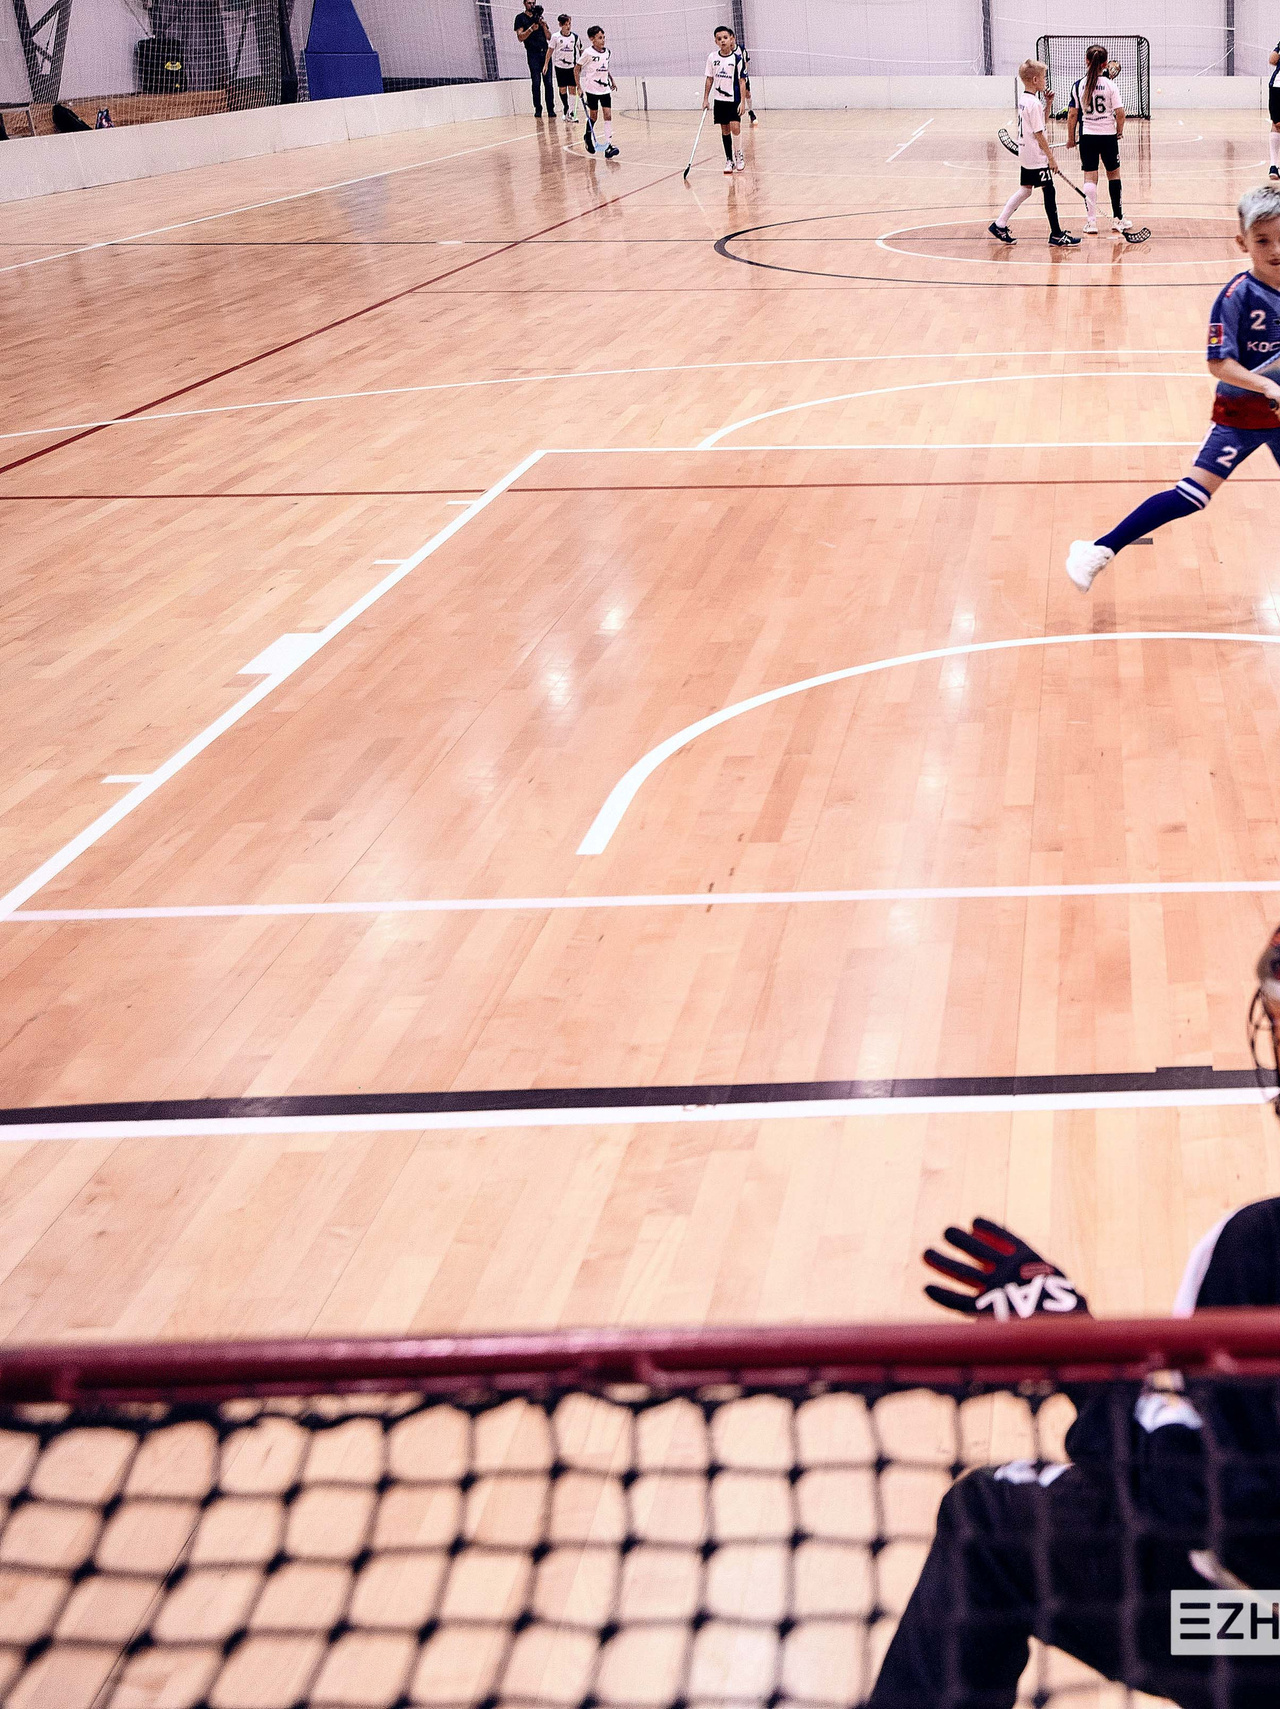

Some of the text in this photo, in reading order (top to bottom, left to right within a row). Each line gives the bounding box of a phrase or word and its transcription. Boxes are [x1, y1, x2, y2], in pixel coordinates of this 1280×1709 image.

[1039, 169, 1052, 182] 21
[1250, 310, 1266, 331] 2
[1216, 446, 1238, 469] 2
